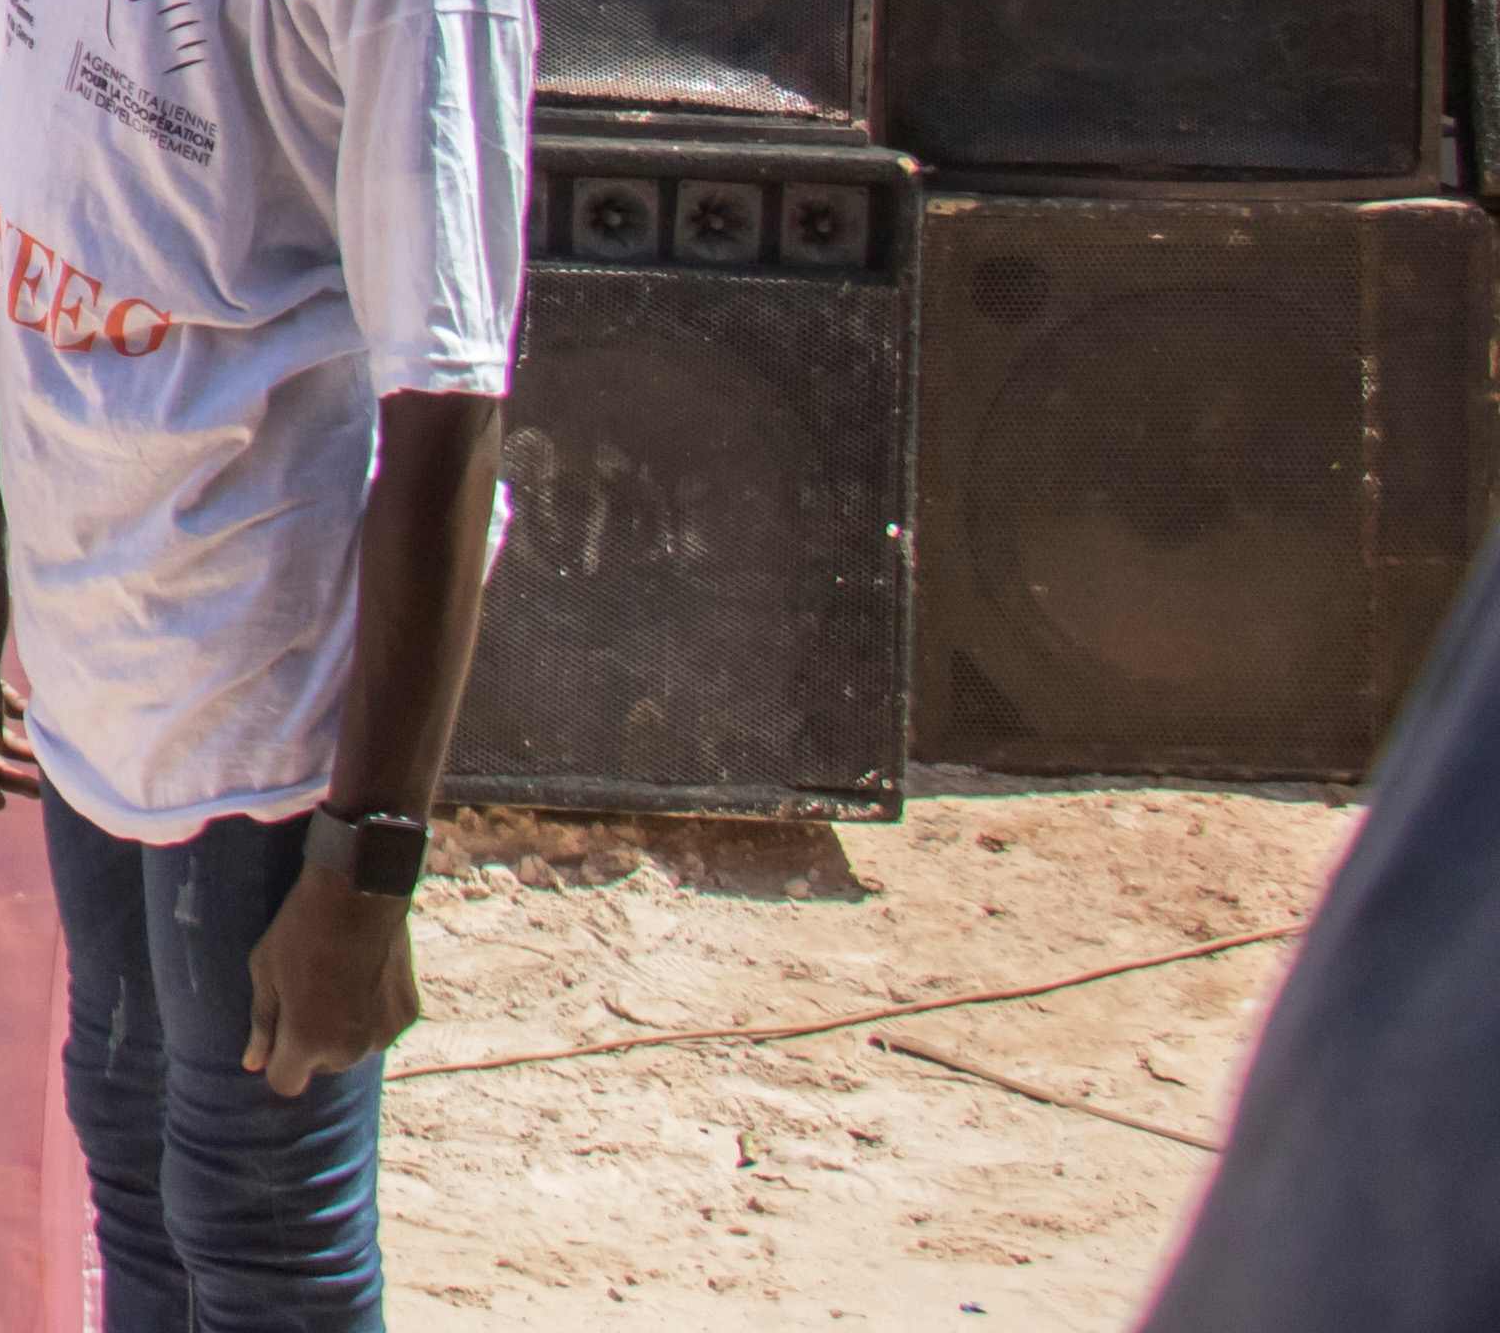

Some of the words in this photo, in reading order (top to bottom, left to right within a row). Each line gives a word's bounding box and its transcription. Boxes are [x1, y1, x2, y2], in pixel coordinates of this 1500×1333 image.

[75, 81, 92, 101] AU
[80, 65, 109, 93] POUR
[109, 84, 121, 101] LA
[83, 50, 136, 96] AGENCE
[138, 88, 218, 138] ITALIENNE
